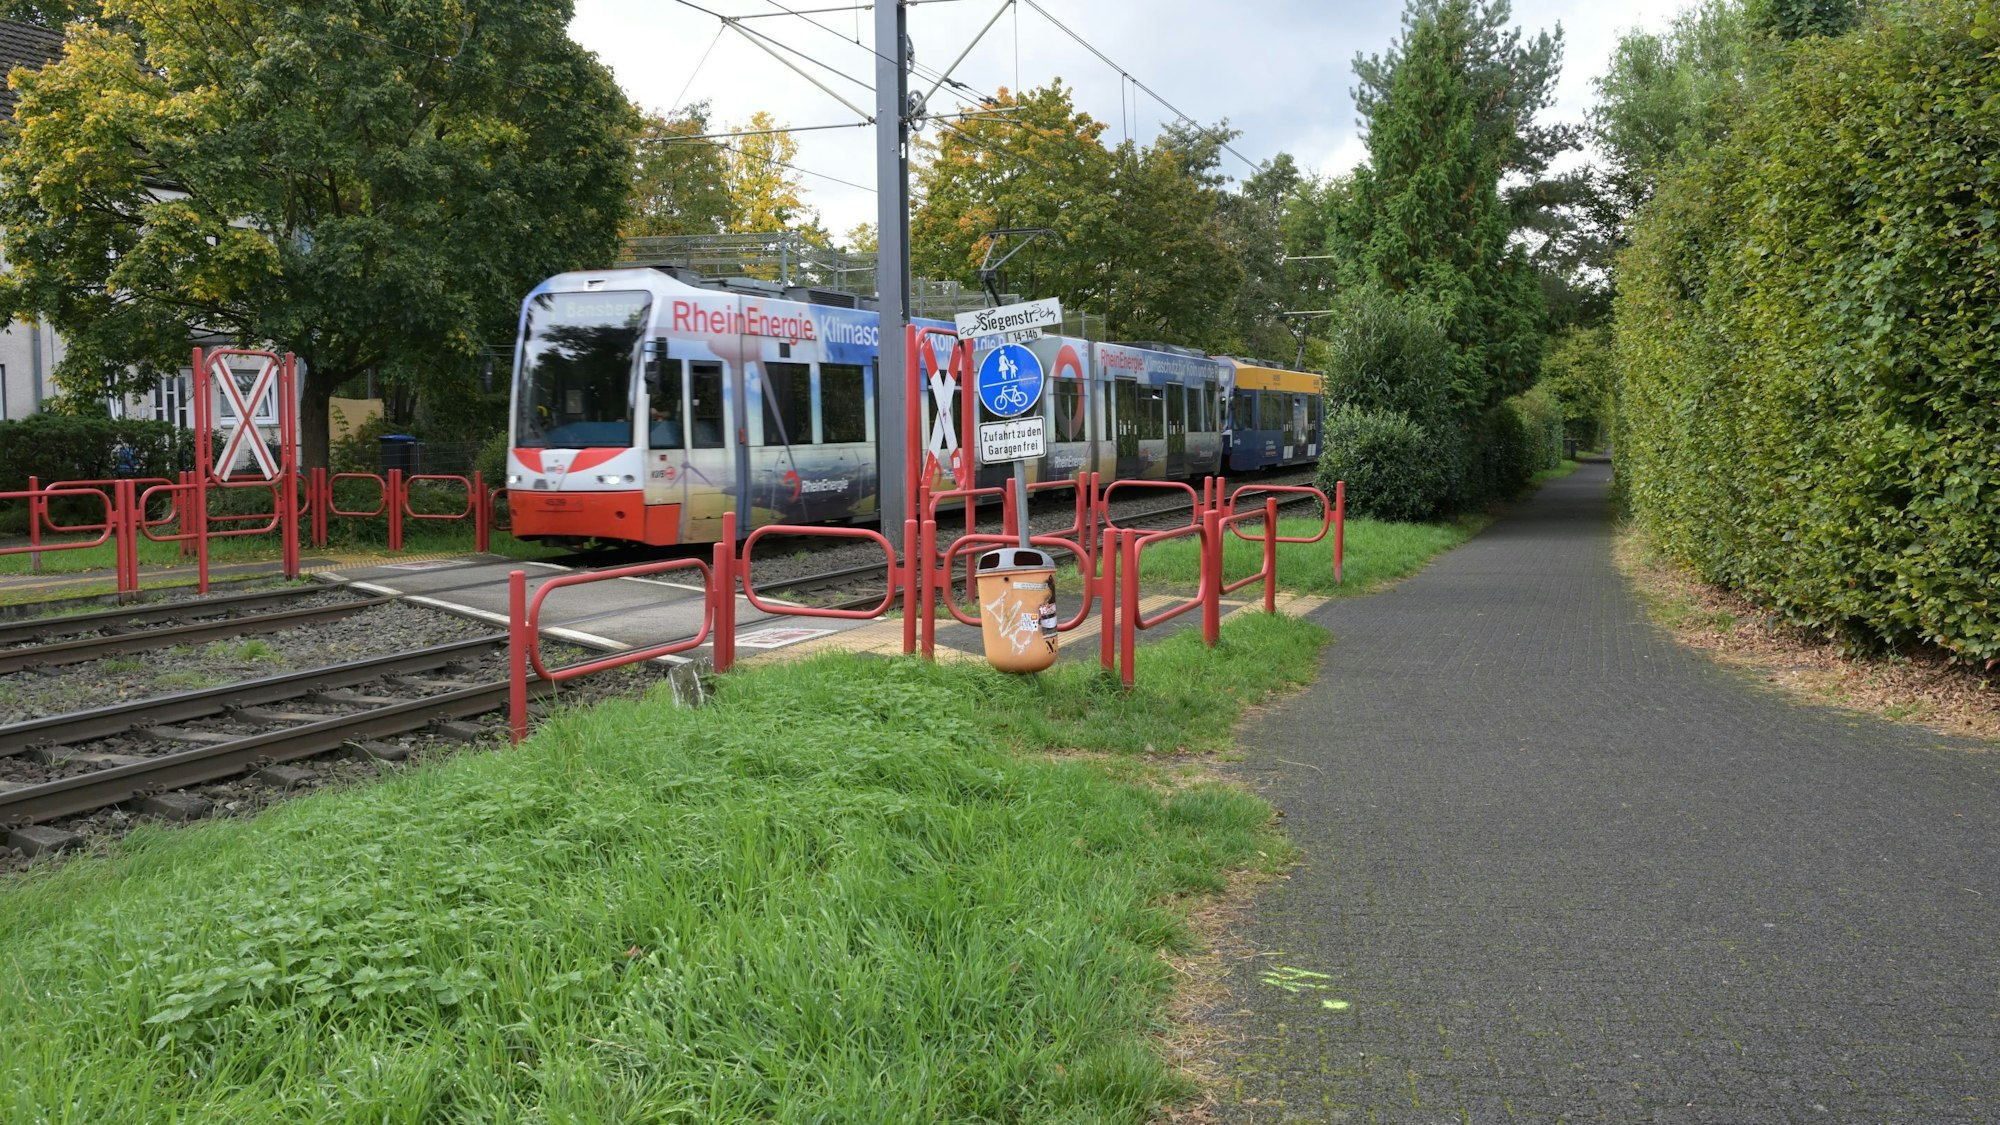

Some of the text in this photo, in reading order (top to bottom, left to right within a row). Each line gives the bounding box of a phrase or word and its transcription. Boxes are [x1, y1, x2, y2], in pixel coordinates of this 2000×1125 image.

[673, 300, 817, 345] RheinEnergie.
[820, 315, 879, 346] Klimasc
[980, 310, 1039, 331] Siegenstr.
[1013, 329, 1038, 342] 14-14b
[983, 427, 1042, 442] Zufahrt zu den
[988, 440, 1038, 455] Garagen frei
[801, 477, 849, 493] RheinEnergie
